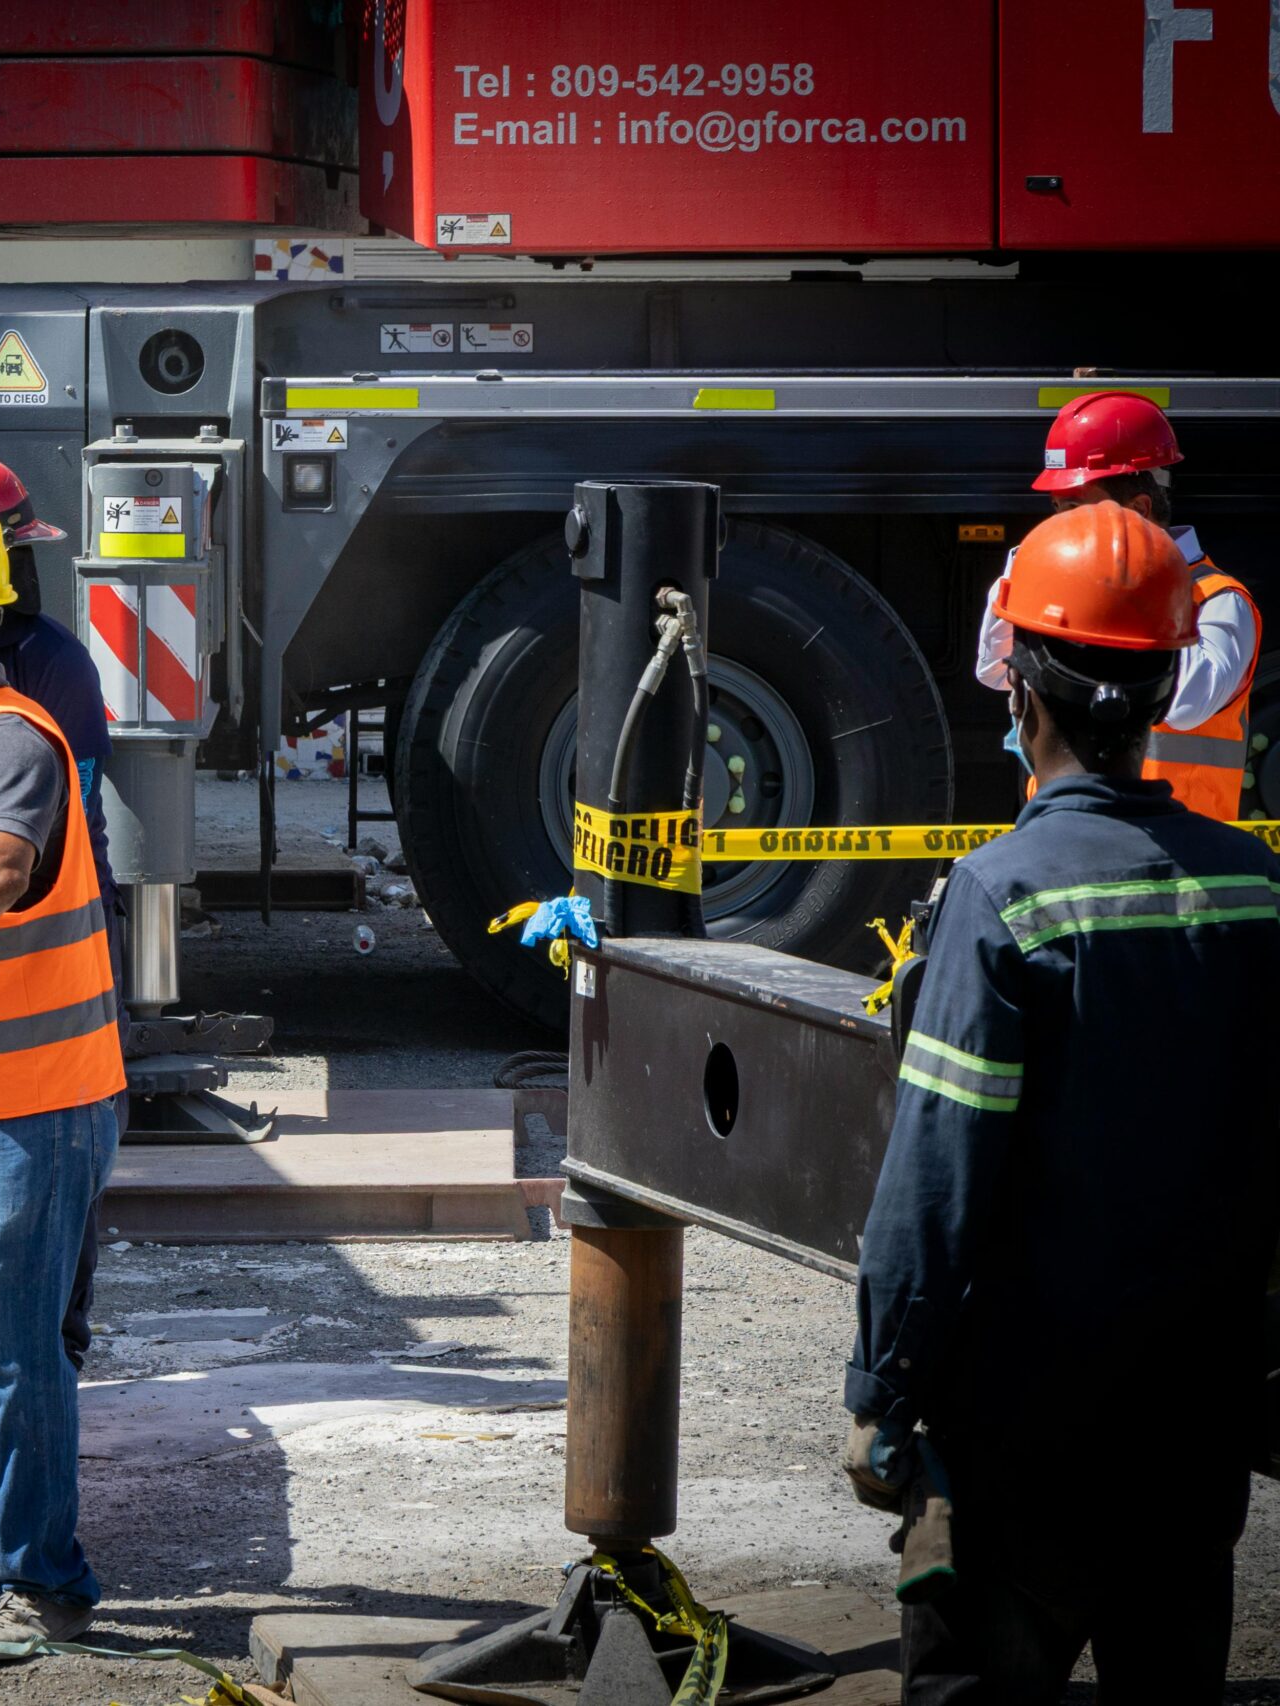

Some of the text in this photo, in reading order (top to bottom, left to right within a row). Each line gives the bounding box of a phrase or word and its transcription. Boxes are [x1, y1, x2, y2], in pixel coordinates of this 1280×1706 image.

[454, 63, 814, 97] Tel : 809-542-9958
[453, 110, 965, 152] E-mail : info@gforca.com
[13, 394, 46, 404] CIEGO
[574, 826, 674, 882] PELIGRO
